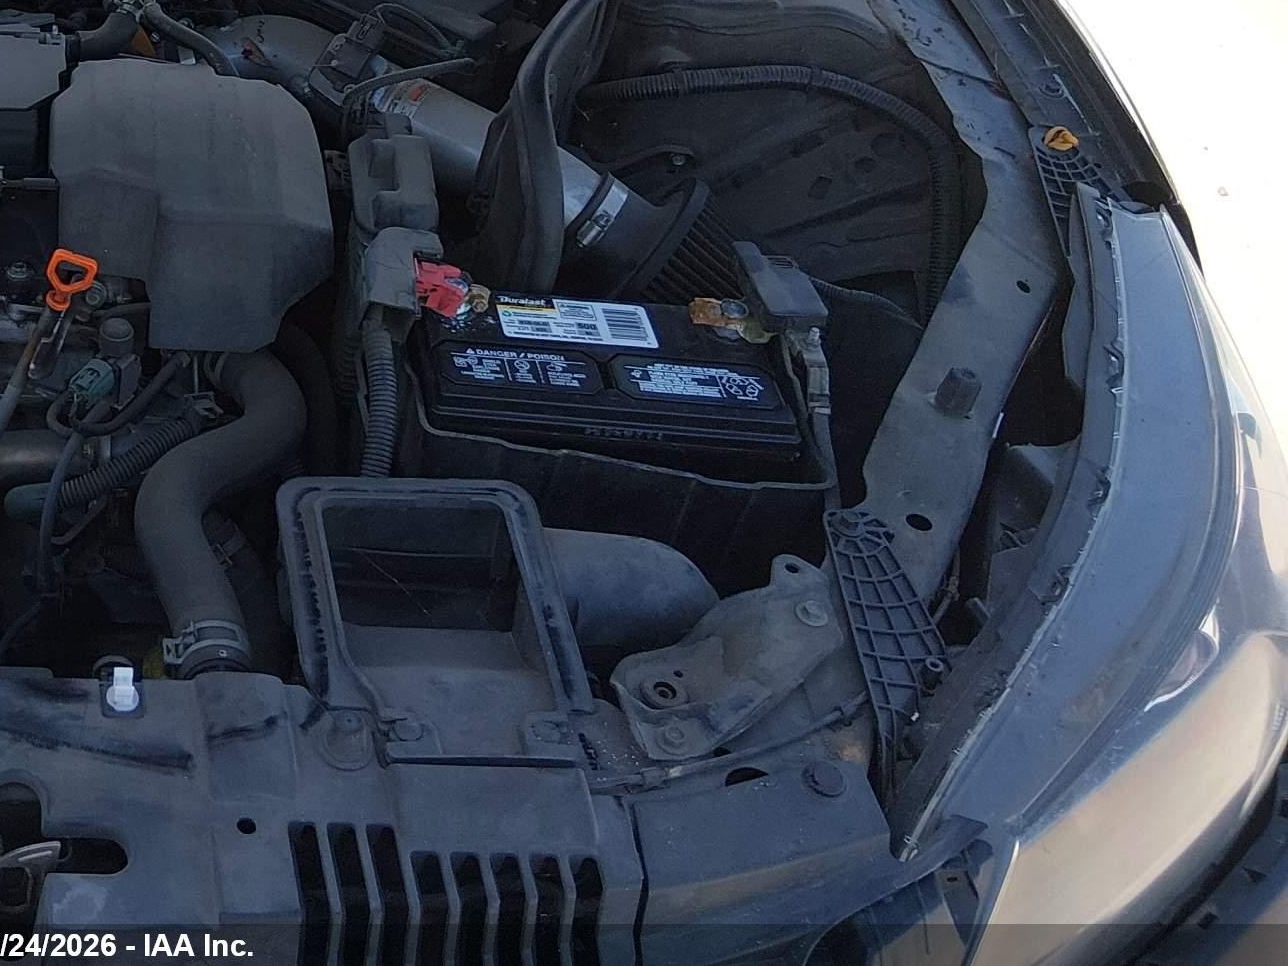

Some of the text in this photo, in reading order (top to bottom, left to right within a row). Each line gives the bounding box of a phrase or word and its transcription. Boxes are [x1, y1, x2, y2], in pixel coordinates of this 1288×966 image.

[498, 295, 546, 305] Duralast
[476, 348, 518, 358] DANGER
[527, 352, 565, 362] POISON
